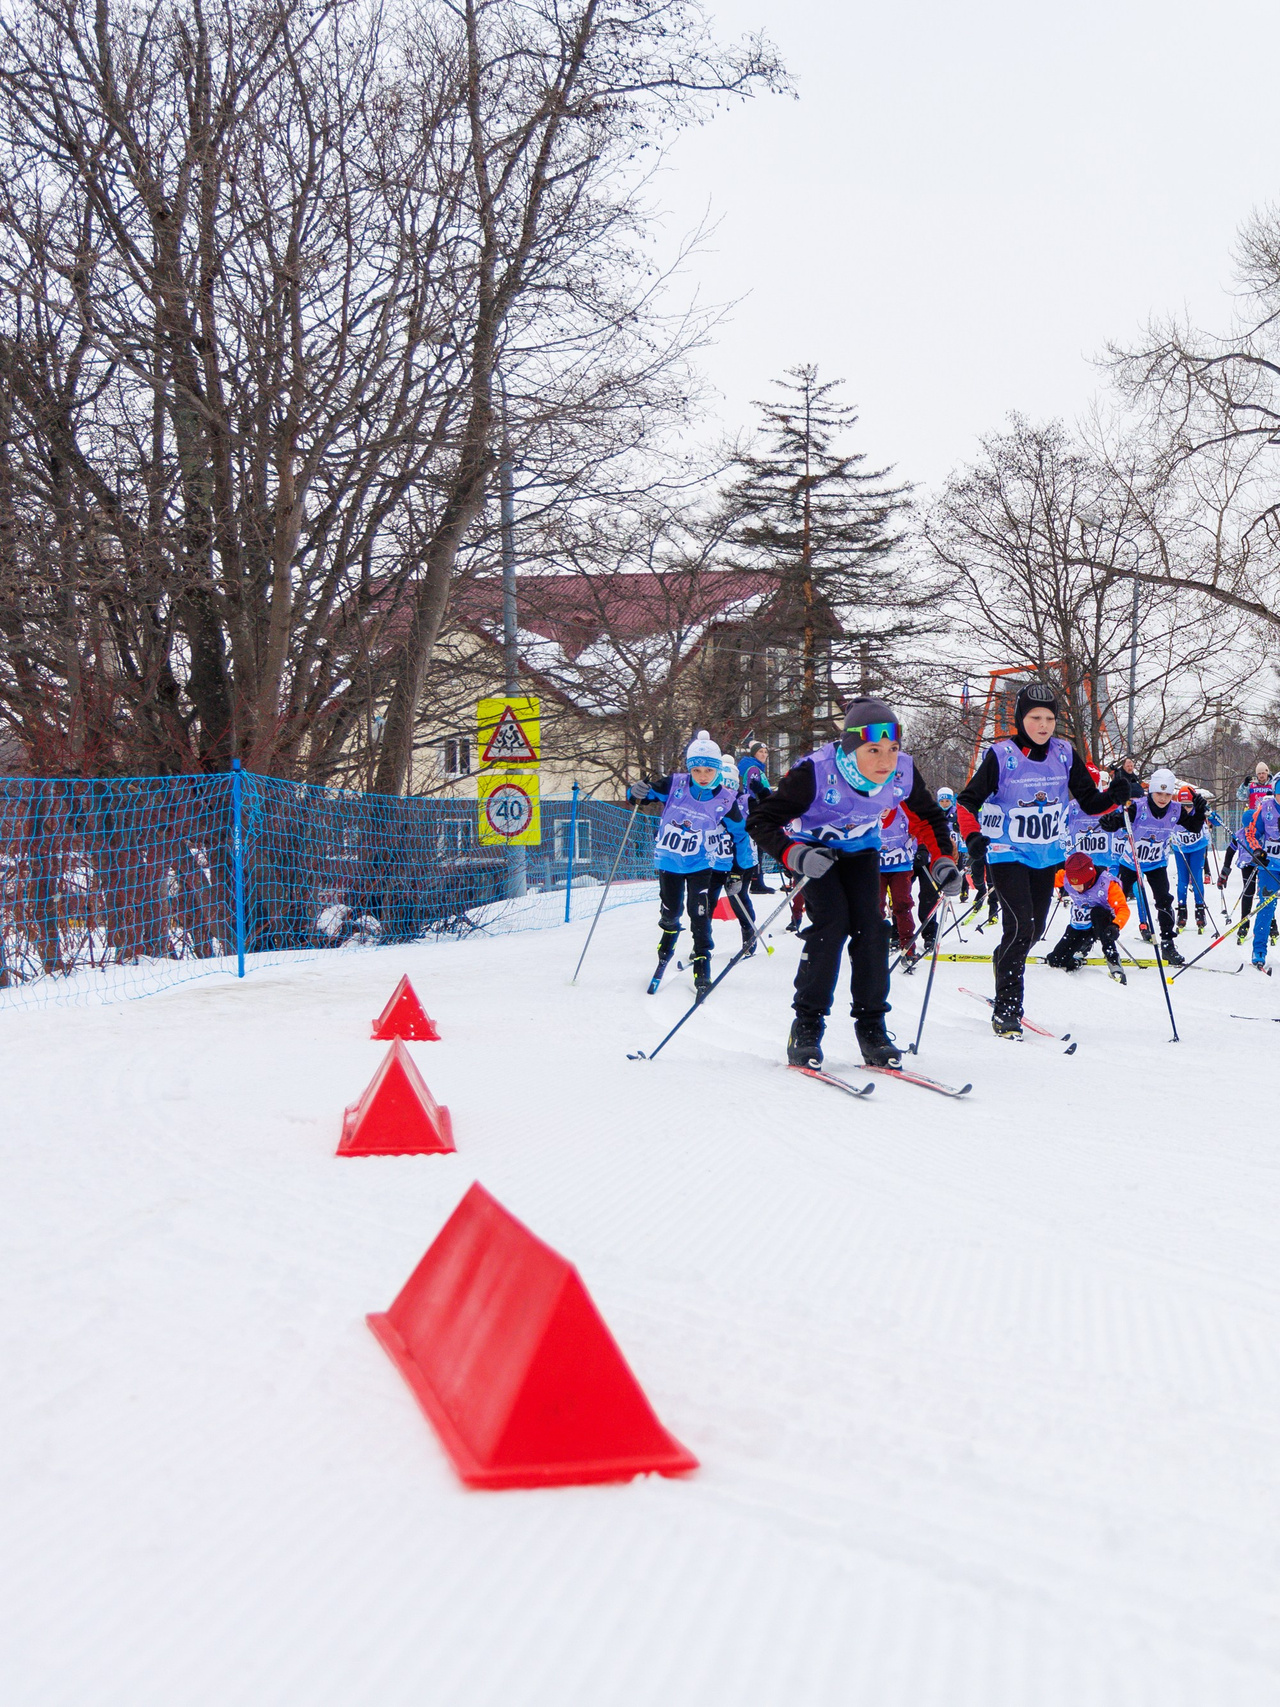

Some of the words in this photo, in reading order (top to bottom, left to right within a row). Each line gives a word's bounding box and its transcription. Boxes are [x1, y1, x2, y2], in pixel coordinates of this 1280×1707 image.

[496, 800, 522, 820] 40
[983, 814, 1001, 829] 1002
[1014, 810, 1060, 841] 1002
[661, 831, 698, 853] 1016
[1078, 836, 1106, 851] 1008
